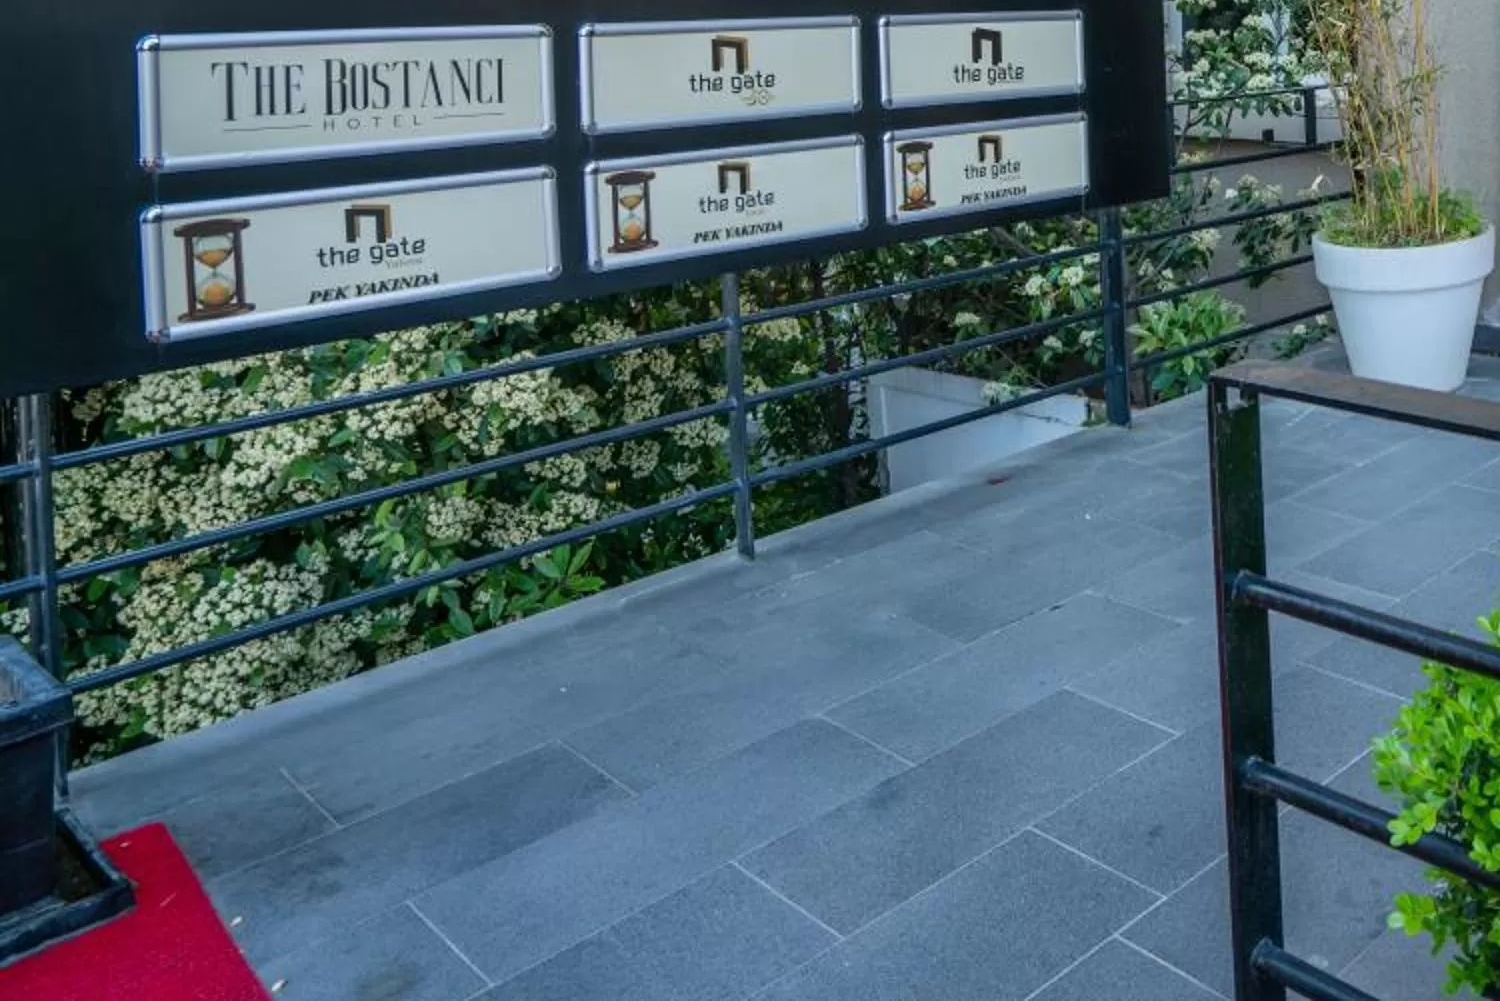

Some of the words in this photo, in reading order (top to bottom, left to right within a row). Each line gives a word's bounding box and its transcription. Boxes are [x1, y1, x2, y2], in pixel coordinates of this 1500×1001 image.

[689, 73, 723, 92] the
[731, 71, 776, 94] gate
[953, 64, 981, 83] the
[987, 62, 1024, 85] gate
[211, 61, 306, 122] THE
[323, 58, 506, 116] BOSTANCI
[323, 113, 423, 132] HOTEL
[963, 164, 987, 179] the
[991, 160, 1021, 179] gate
[698, 195, 729, 213] the
[735, 190, 775, 212] gate
[693, 228, 721, 243] PEK
[316, 246, 360, 268] the
[369, 236, 426, 264] gate
[307, 284, 350, 304] PEK
[355, 272, 440, 297] YAKINDA
